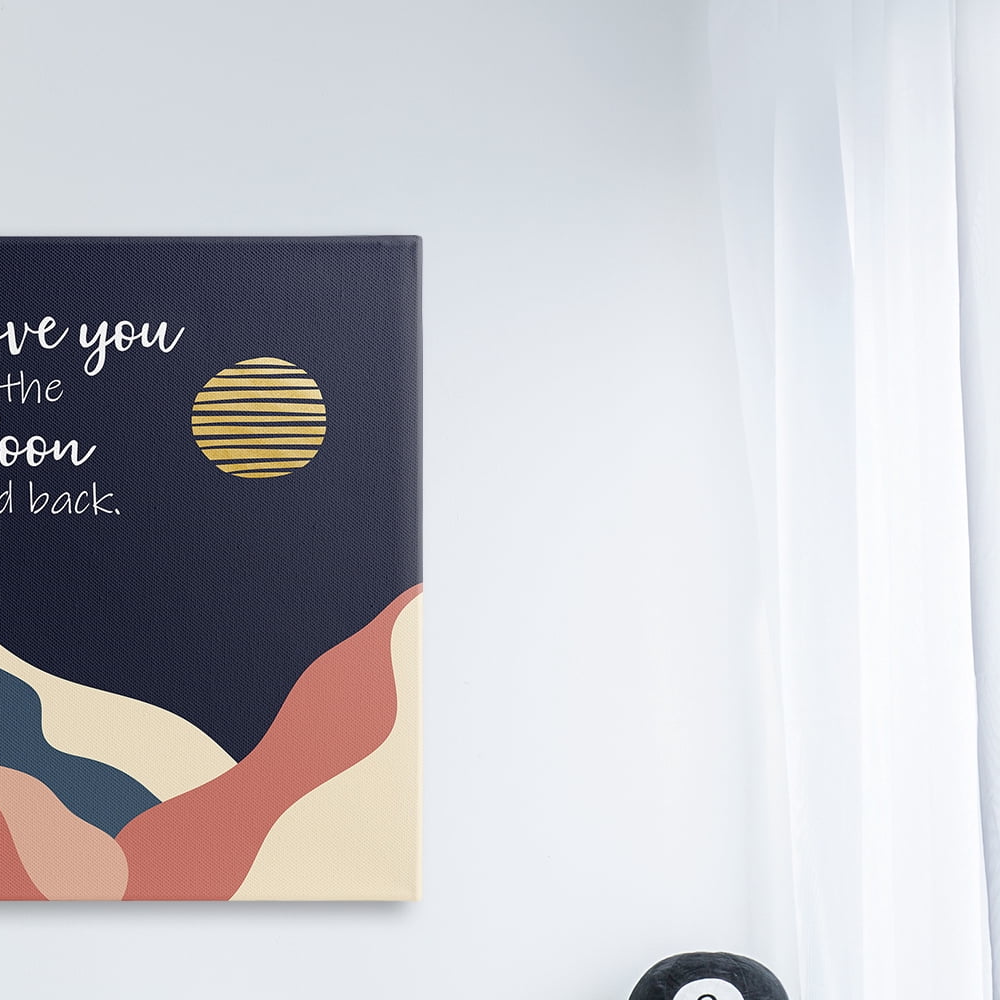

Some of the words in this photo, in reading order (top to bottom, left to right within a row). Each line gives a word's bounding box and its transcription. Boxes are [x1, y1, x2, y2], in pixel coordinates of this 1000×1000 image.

[79, 321, 185, 376] you
[0, 371, 63, 404] the
[29, 481, 120, 515] back.
